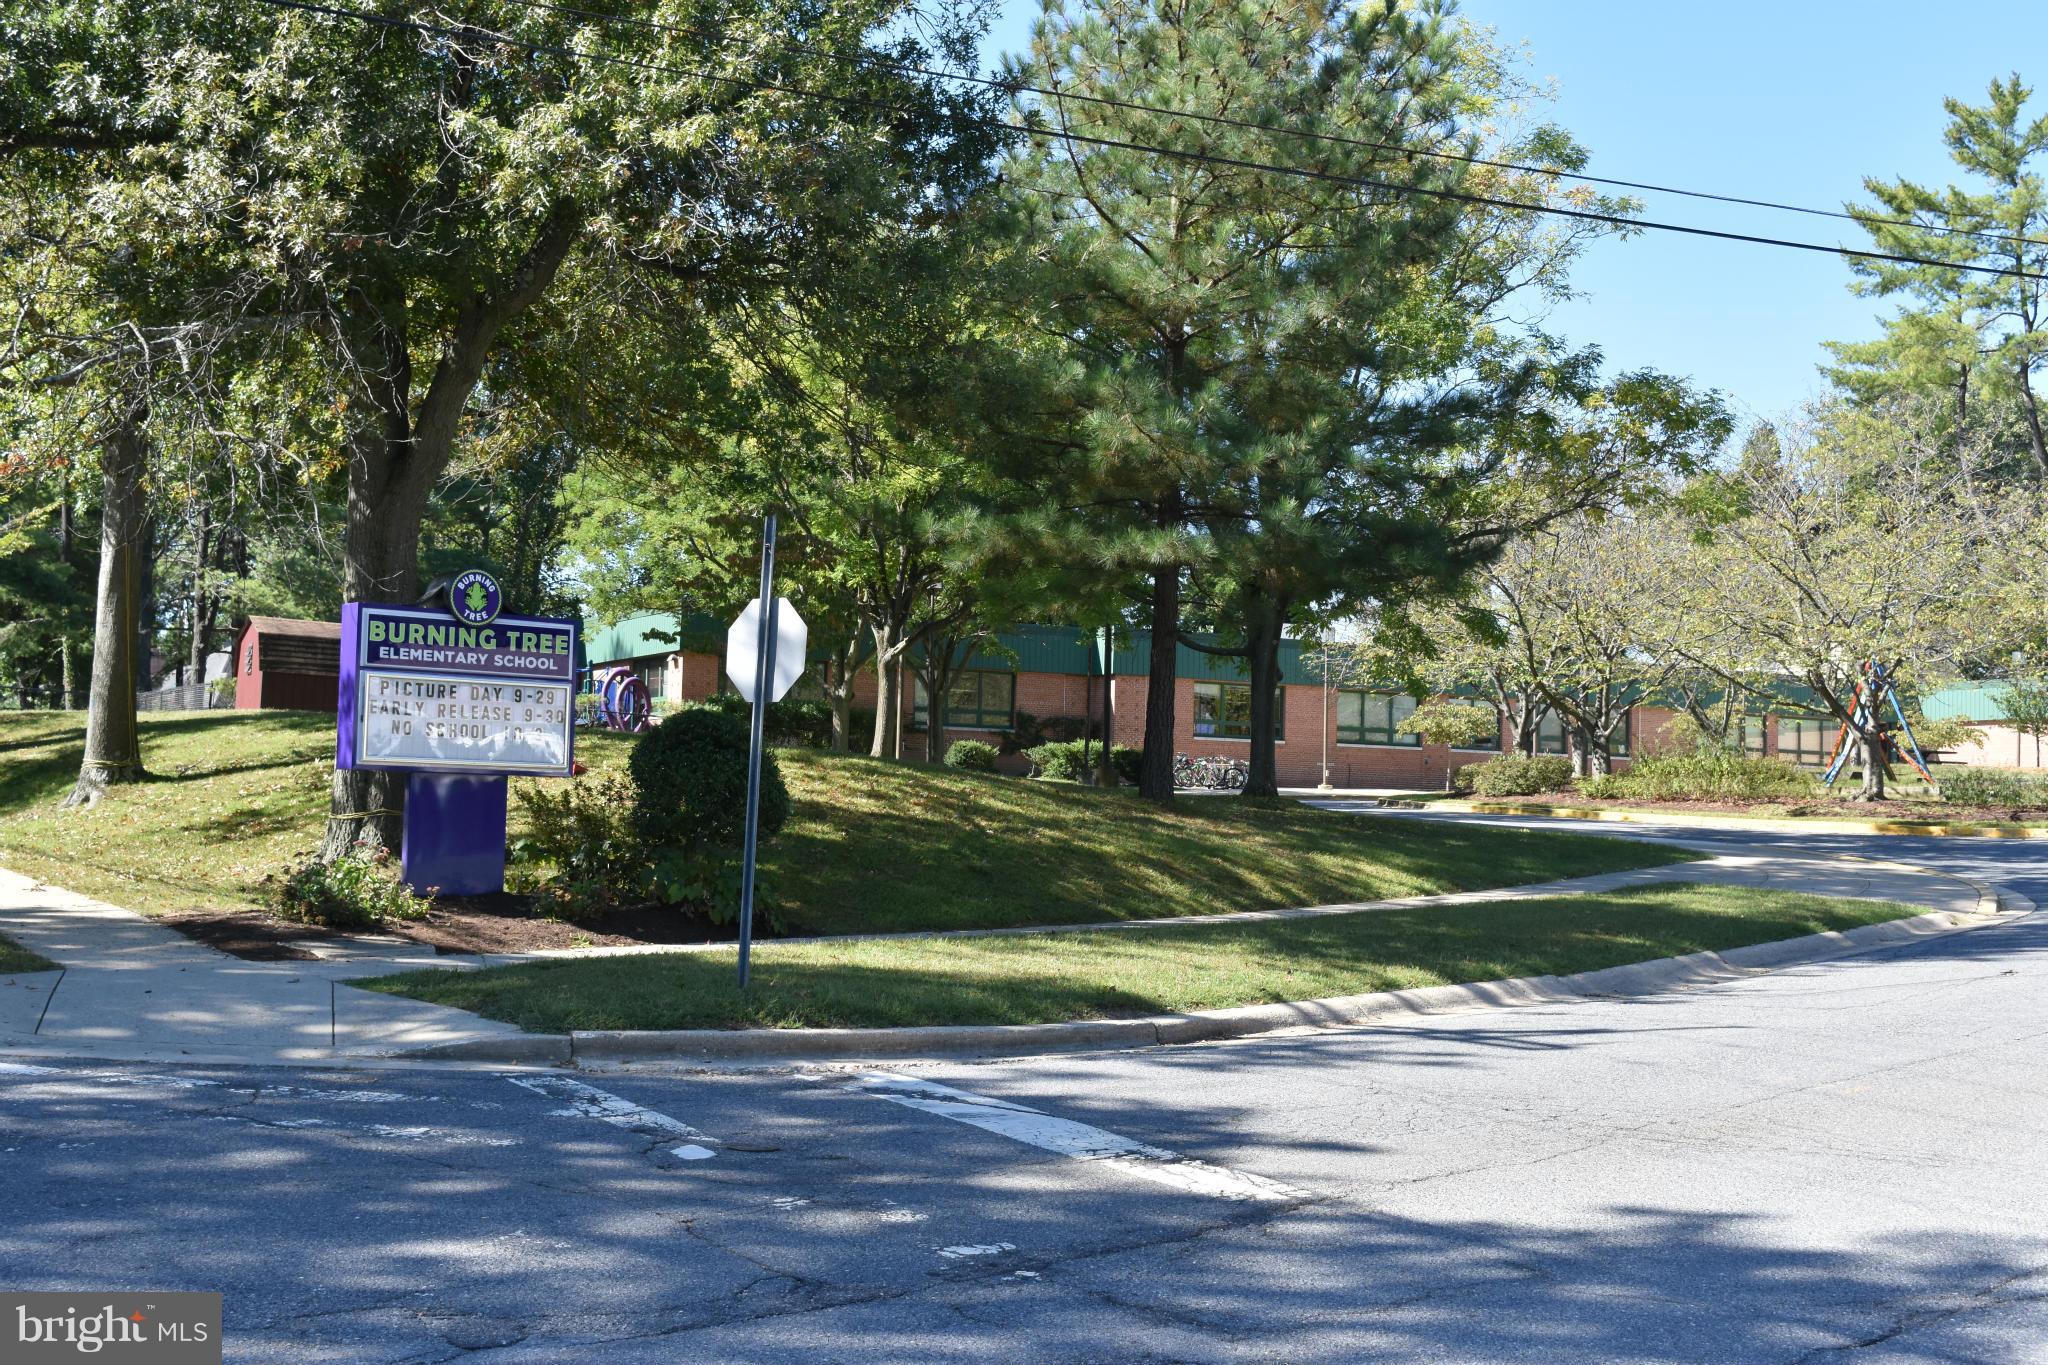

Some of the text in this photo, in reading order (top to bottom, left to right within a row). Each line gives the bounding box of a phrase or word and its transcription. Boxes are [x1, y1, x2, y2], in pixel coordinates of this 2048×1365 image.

[457, 574, 496, 592] BURNING
[464, 609, 489, 621] TREE
[369, 620, 569, 655] BURNING TREE
[379, 646, 558, 670] ELEMENTARY SCHOOL
[380, 680, 554, 705] PICTURE DAY 9-29
[369, 699, 564, 723] EARLY RELEASE 9-30
[391, 720, 412, 735] NO
[426, 722, 488, 739] SCHOOL
